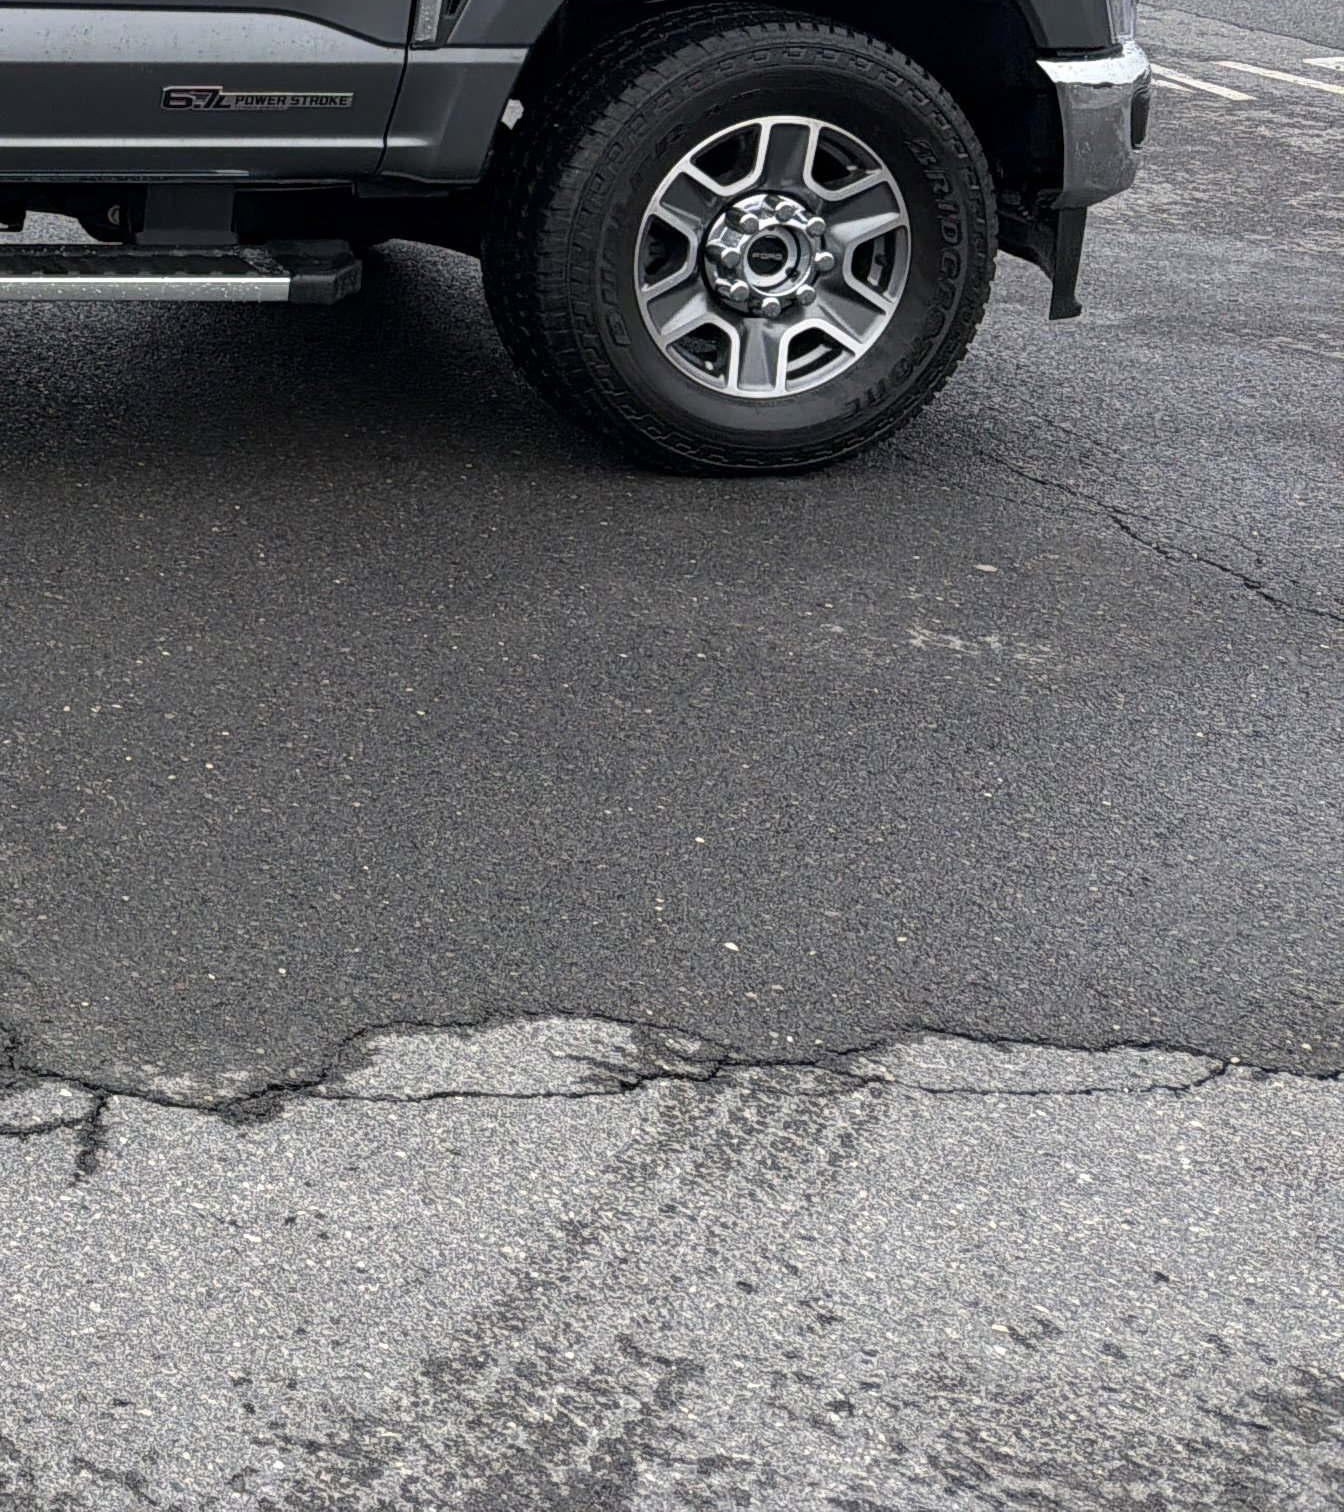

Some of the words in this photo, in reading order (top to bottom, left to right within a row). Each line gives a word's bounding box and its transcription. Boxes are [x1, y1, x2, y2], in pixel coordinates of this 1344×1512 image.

[162, 87, 233, 110] 6.7L
[234, 95, 289, 107] POWER
[289, 95, 349, 107] STROKE
[751, 252, 783, 261] FORD
